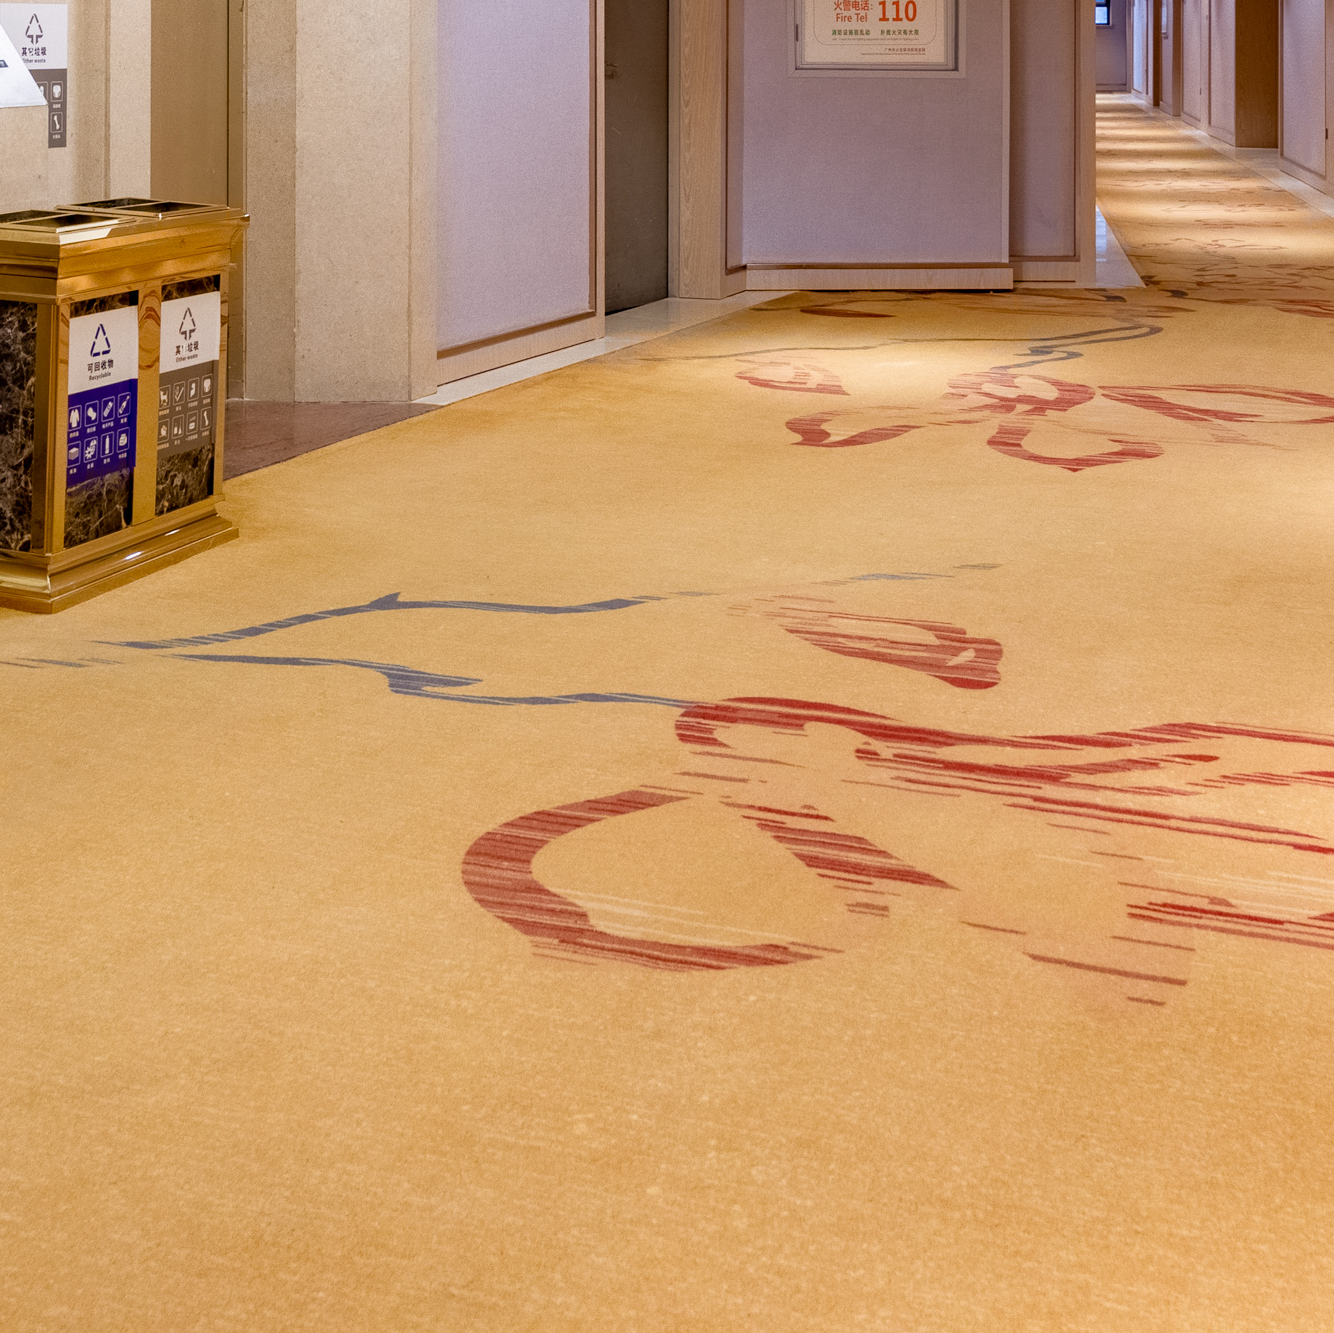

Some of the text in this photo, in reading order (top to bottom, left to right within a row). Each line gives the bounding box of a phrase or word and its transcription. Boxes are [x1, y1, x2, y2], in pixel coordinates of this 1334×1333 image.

[836, 12, 867, 22] Fire Tel
[878, 0, 917, 22] 110
[175, 340, 199, 356] 其垃圾
[87, 359, 114, 374] 可回收物
[88, 372, 112, 381] Recyclable
